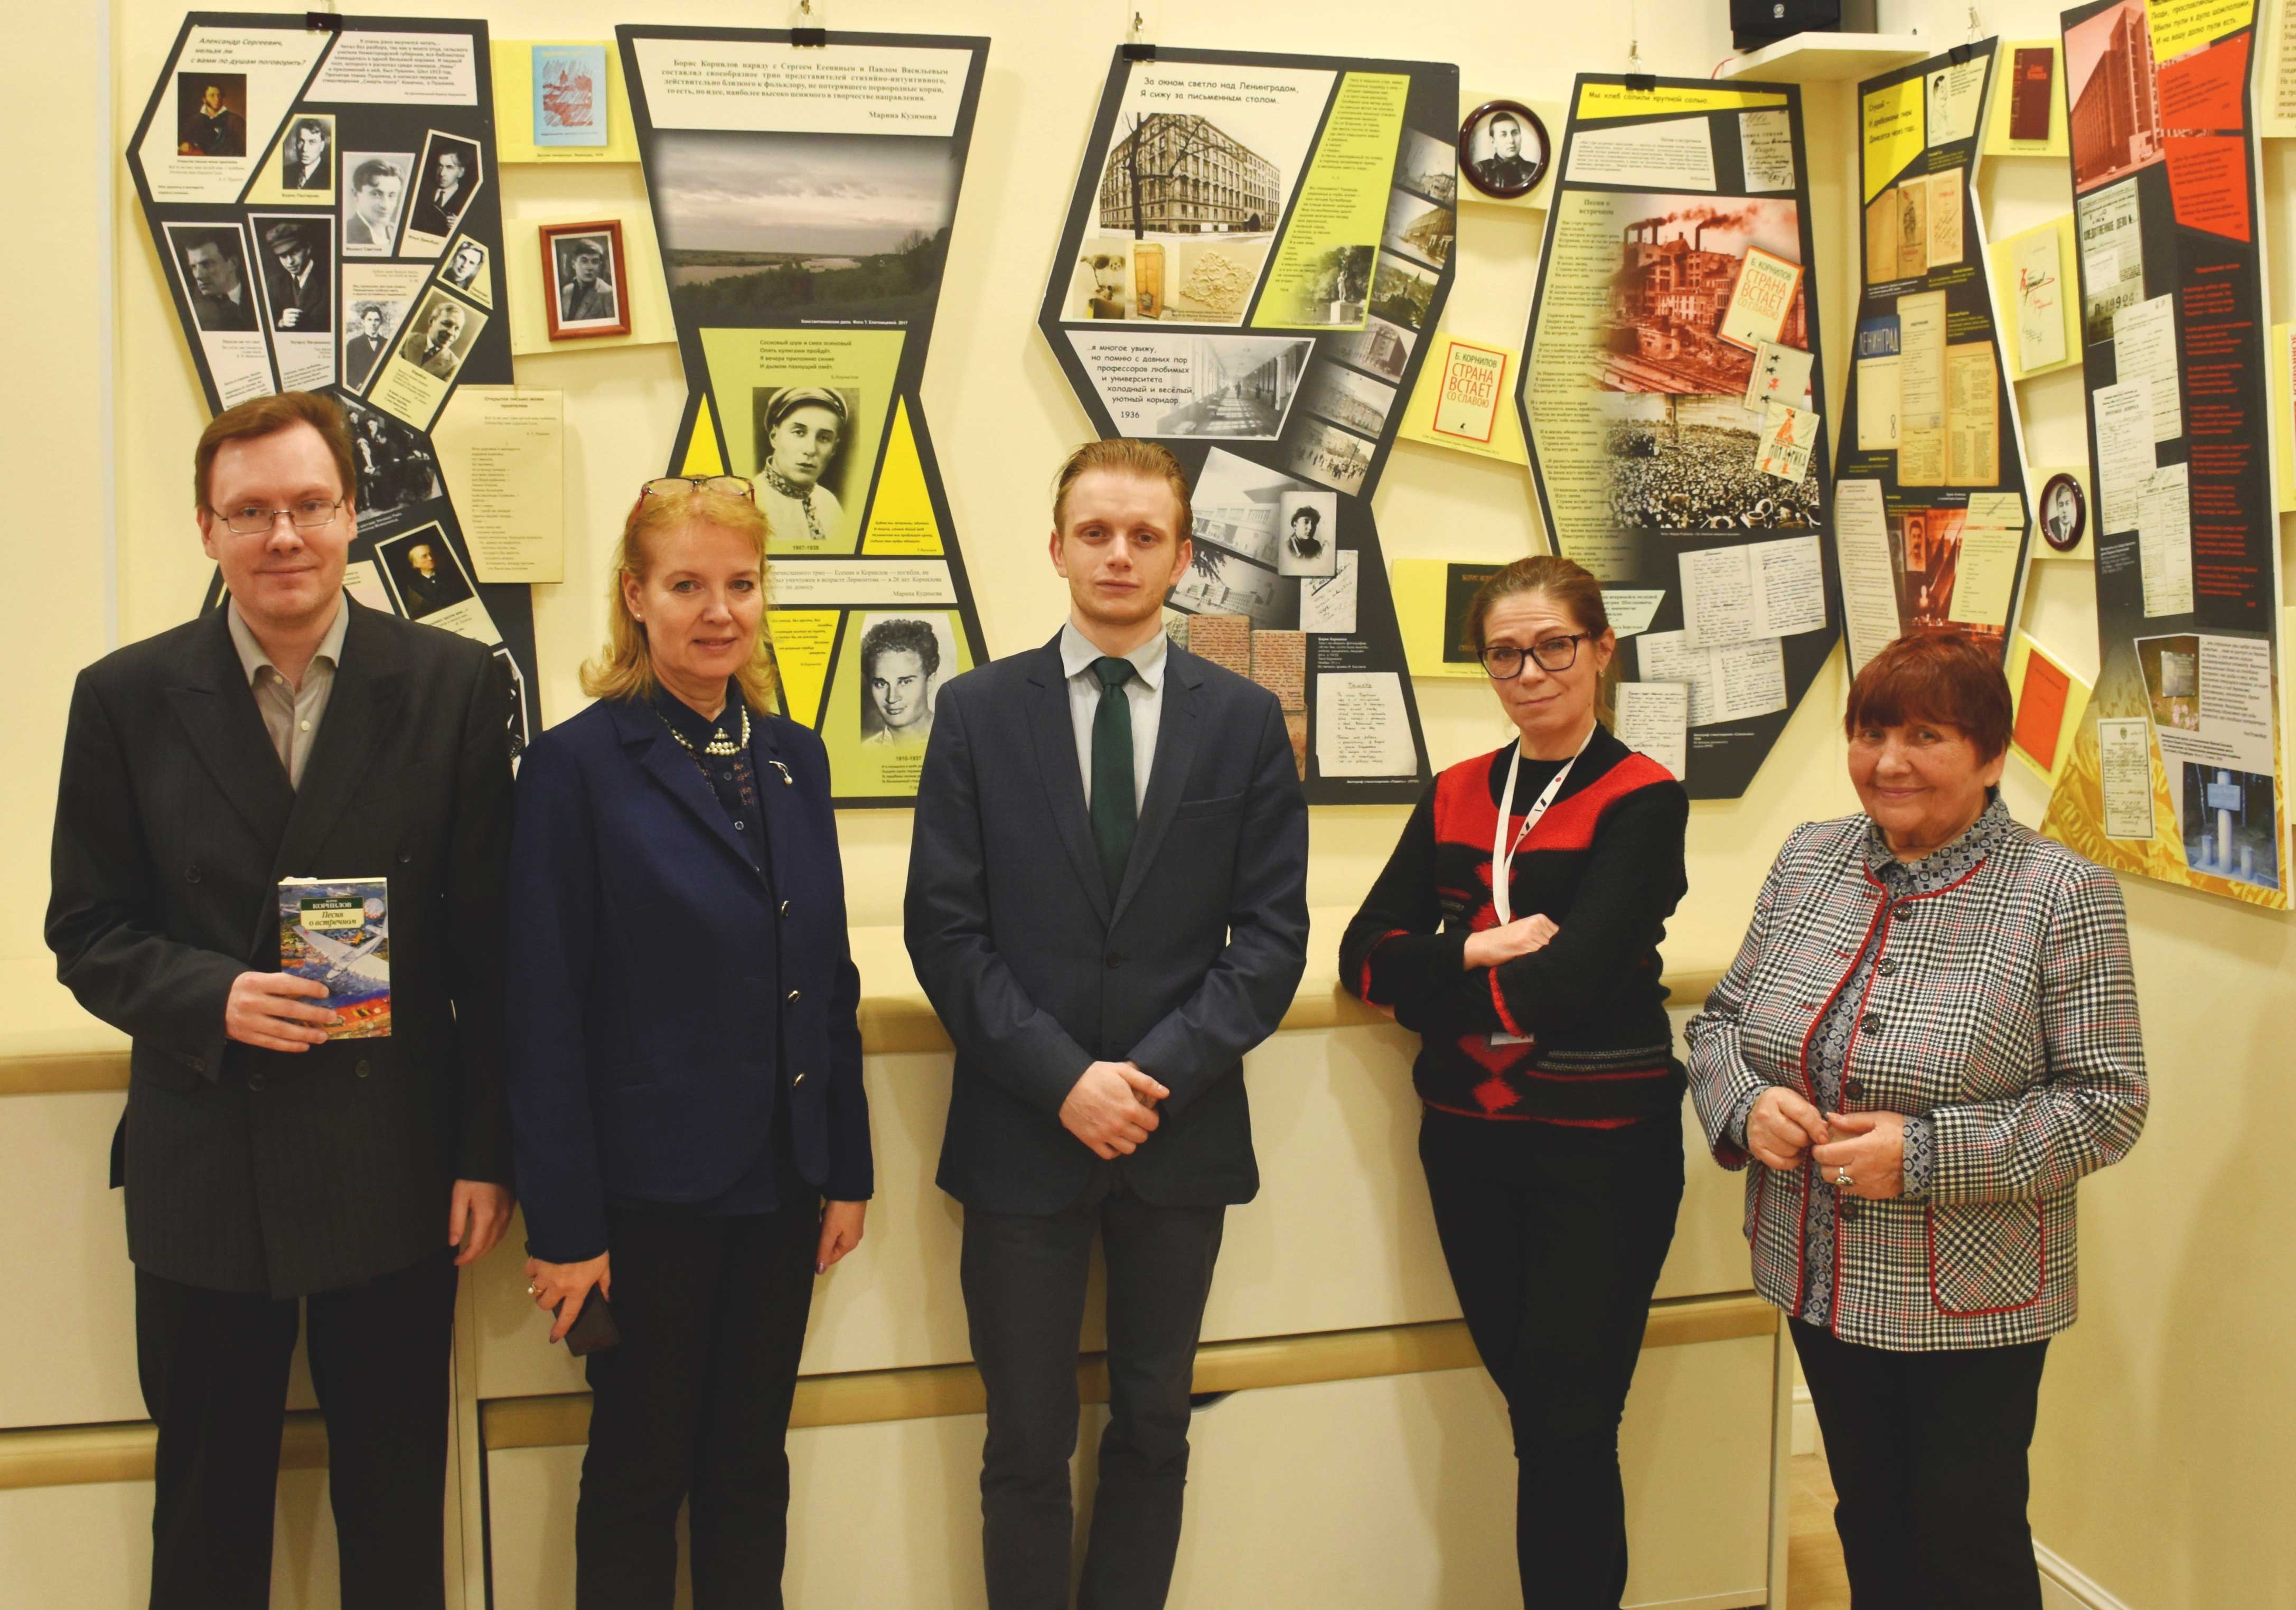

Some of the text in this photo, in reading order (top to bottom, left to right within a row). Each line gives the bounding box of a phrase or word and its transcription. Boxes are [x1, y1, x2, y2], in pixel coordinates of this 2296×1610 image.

[2174, 18, 2188, 27] пули
[2172, 32, 2185, 41] вашу
[2188, 27, 2204, 36] долю
[2207, 22, 2220, 31] пуля
[673, 59, 696, 68] Борис
[763, 81, 807, 90] фольклору,
[1144, 77, 1155, 85] За
[1239, 82, 1299, 93] Ленинградом,
[1187, 93, 1242, 102] письменным
[1747, 269, 1787, 297] СТРАНА
[1741, 283, 1784, 310] ВСТАЕТ
[1463, 354, 1497, 368] КОРНИЛОВ
[1452, 363, 1493, 383] СТРАНА
[1449, 377, 1493, 399] ВСТАЕТ
[1447, 391, 1489, 408] СО СЛАВОЮ
